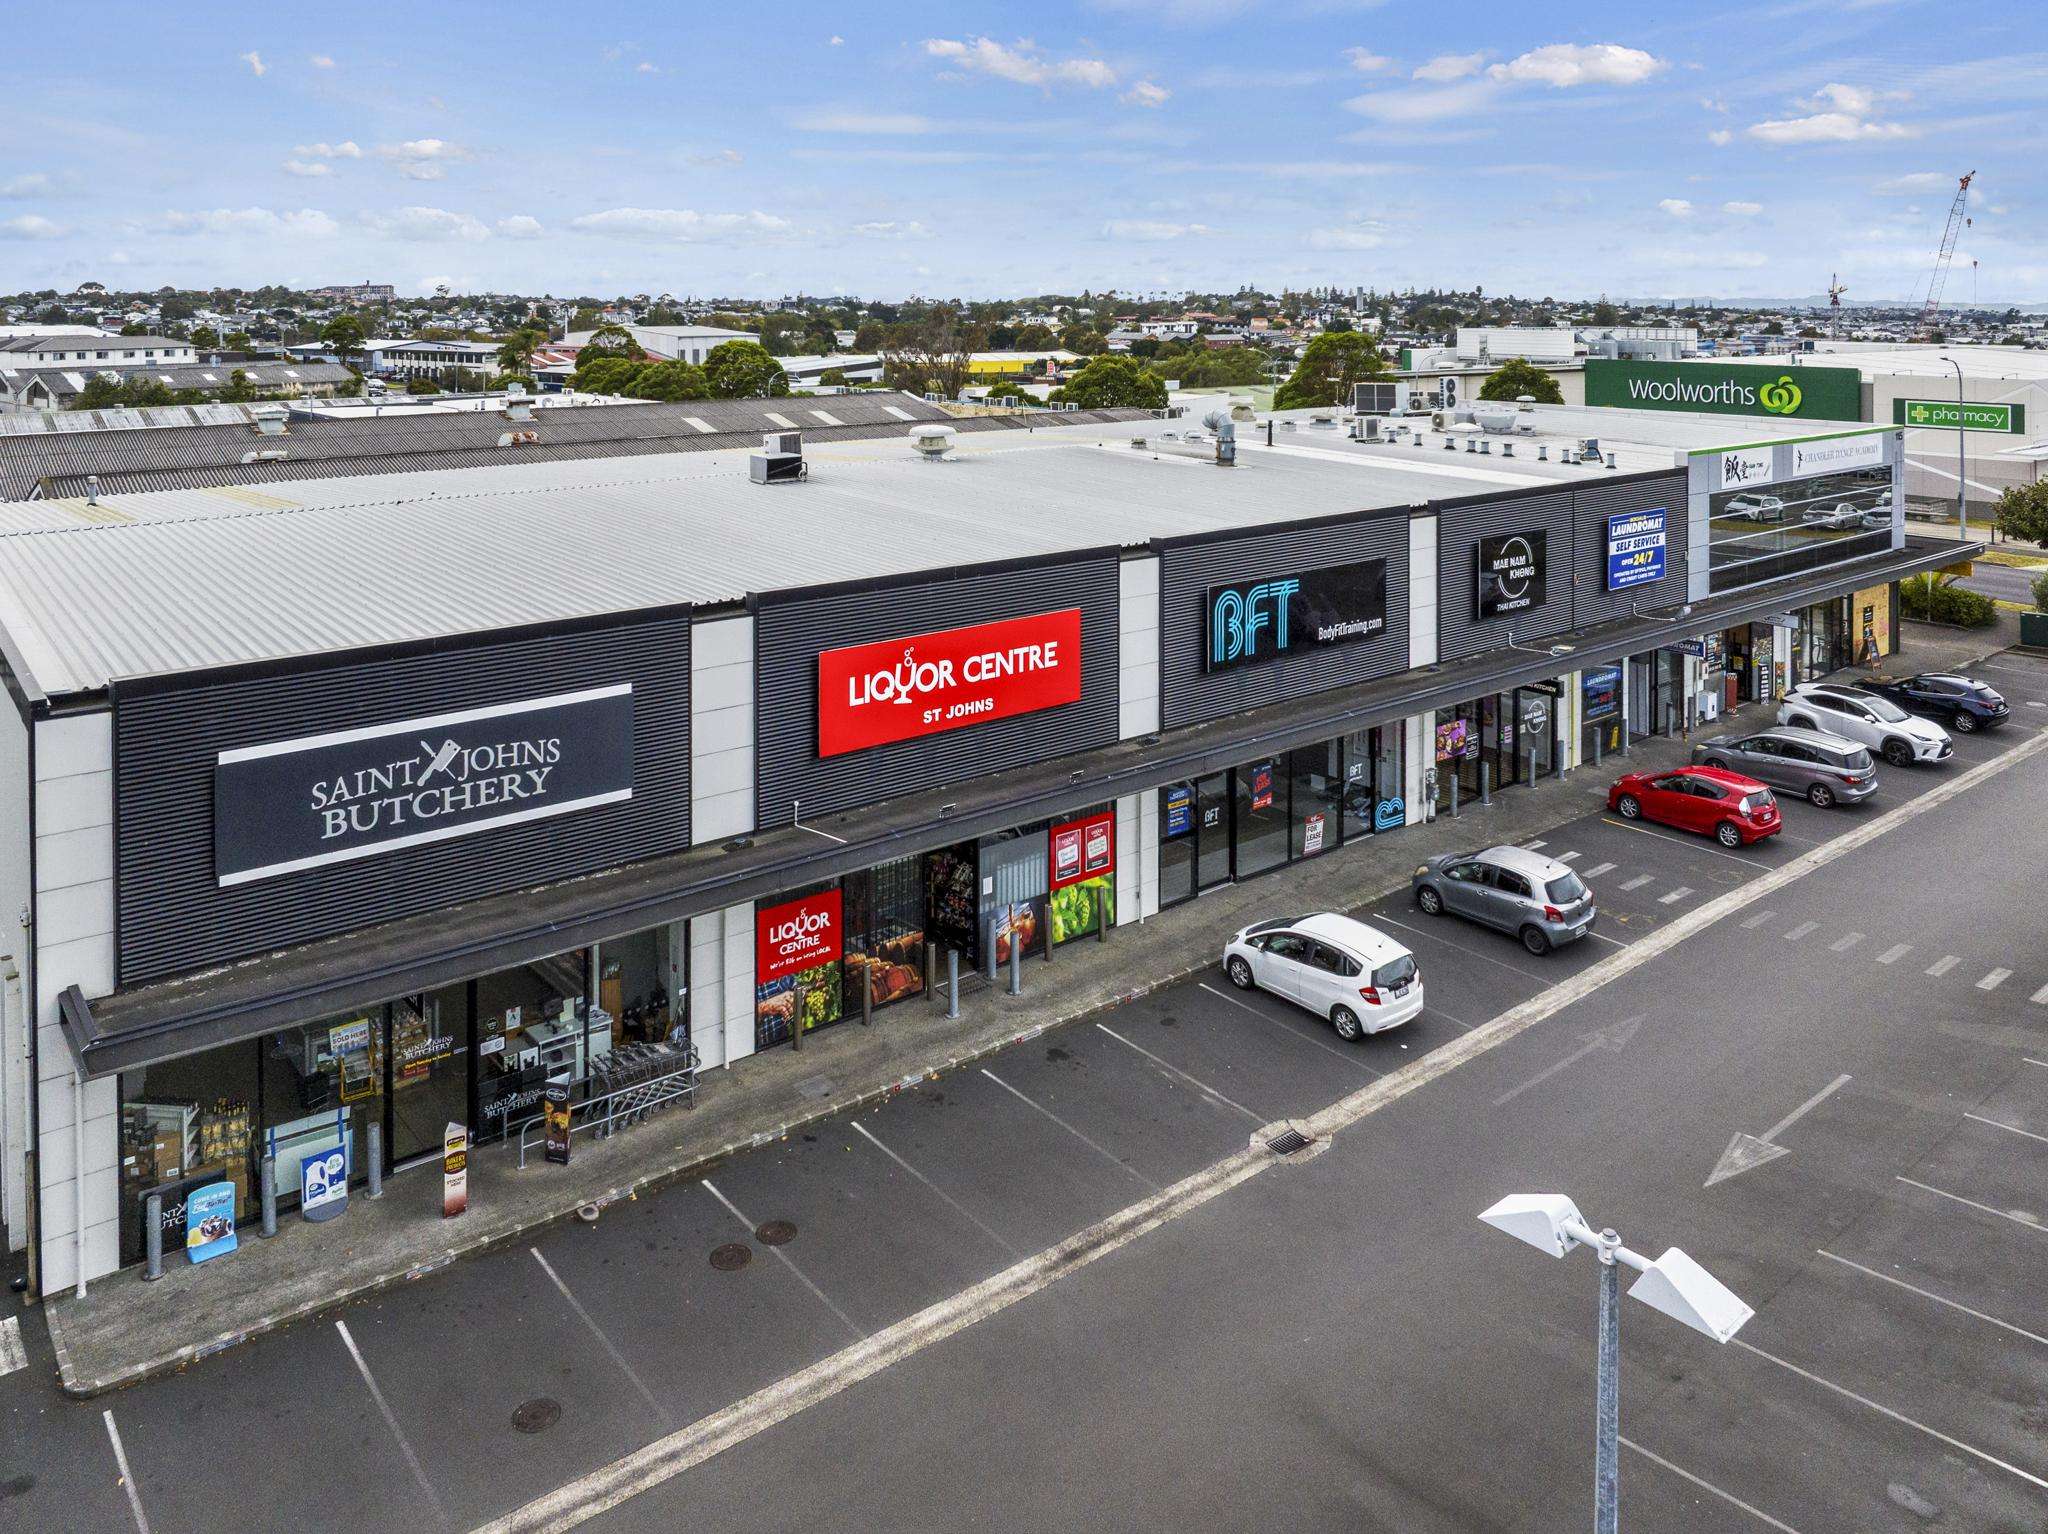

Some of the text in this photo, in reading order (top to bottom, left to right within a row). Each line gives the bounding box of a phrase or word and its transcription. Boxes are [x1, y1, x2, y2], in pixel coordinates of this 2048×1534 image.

[1629, 377, 1755, 405] Woolworths
[1933, 407, 2004, 427] phamacy
[1835, 447, 1854, 459] DANCE
[1612, 518, 1663, 536] LAUNDROMAT
[1616, 535, 1660, 552] SELF SERVICE
[1493, 555, 1526, 569] MAE NAM
[1633, 550, 1654, 565] 24/7
[1497, 598, 1531, 611] THAI KITCHEN
[1215, 579, 1299, 663] BFT
[1318, 617, 1382, 641] BodyFitTraining.com
[849, 641, 1058, 706] LIQUOR CENTRE
[1534, 684, 1557, 692] KITCHEN
[923, 698, 994, 723] ST JOHNS
[311, 738, 561, 811] SAINT JOHNS
[1350, 763, 1363, 776] BFT
[320, 766, 553, 840] BUTCHERY
[1205, 807, 1219, 822] BFT
[1307, 831, 1322, 842] LEASE
[770, 912, 831, 944] LIQUOR
[780, 934, 820, 955] CENTRE
[333, 1034, 349, 1045] SOLD
[350, 1029, 367, 1039] HERE
[404, 1043, 426, 1055] SAINT
[405, 1042, 451, 1060] BUTCHERY
[484, 1098, 508, 1112] SAINT
